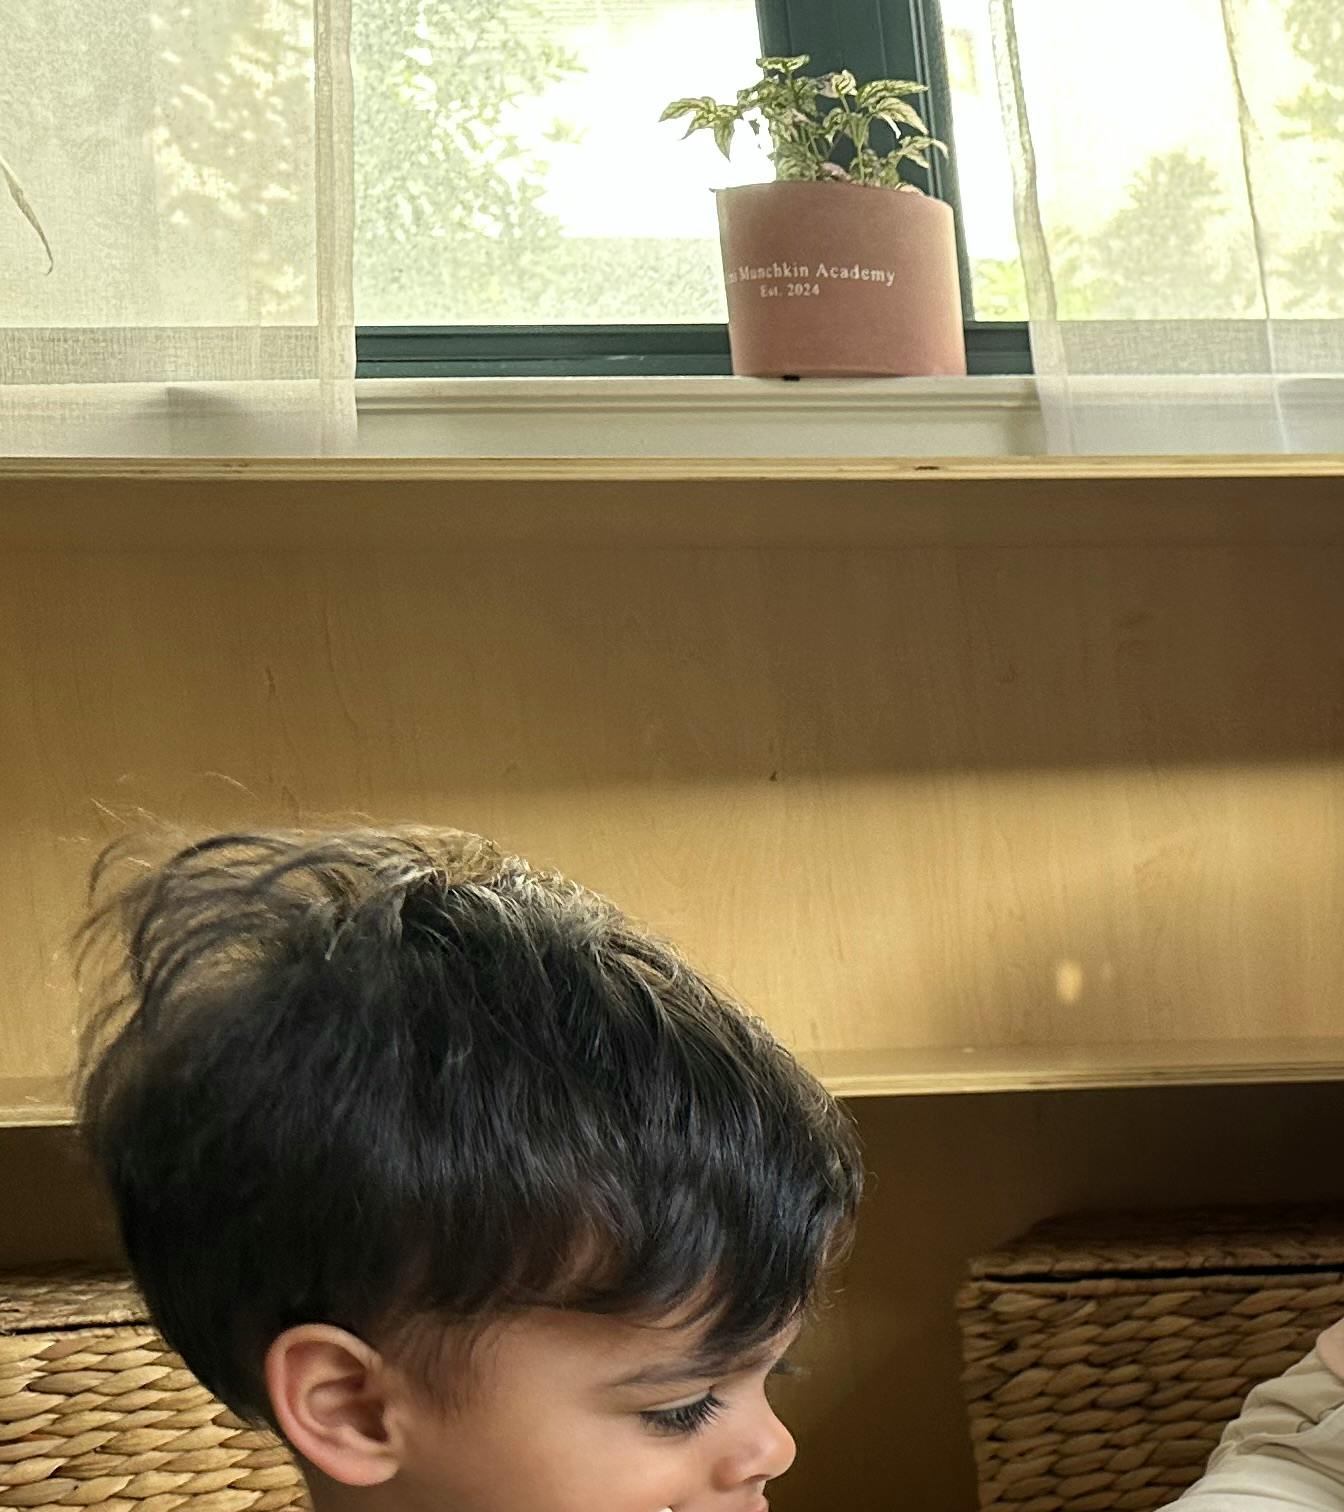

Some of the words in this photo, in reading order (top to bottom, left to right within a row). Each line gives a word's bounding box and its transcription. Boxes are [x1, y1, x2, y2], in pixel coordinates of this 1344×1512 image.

[738, 262, 809, 281] Munchkin
[816, 263, 896, 287] Academy
[787, 283, 820, 297] 2024
